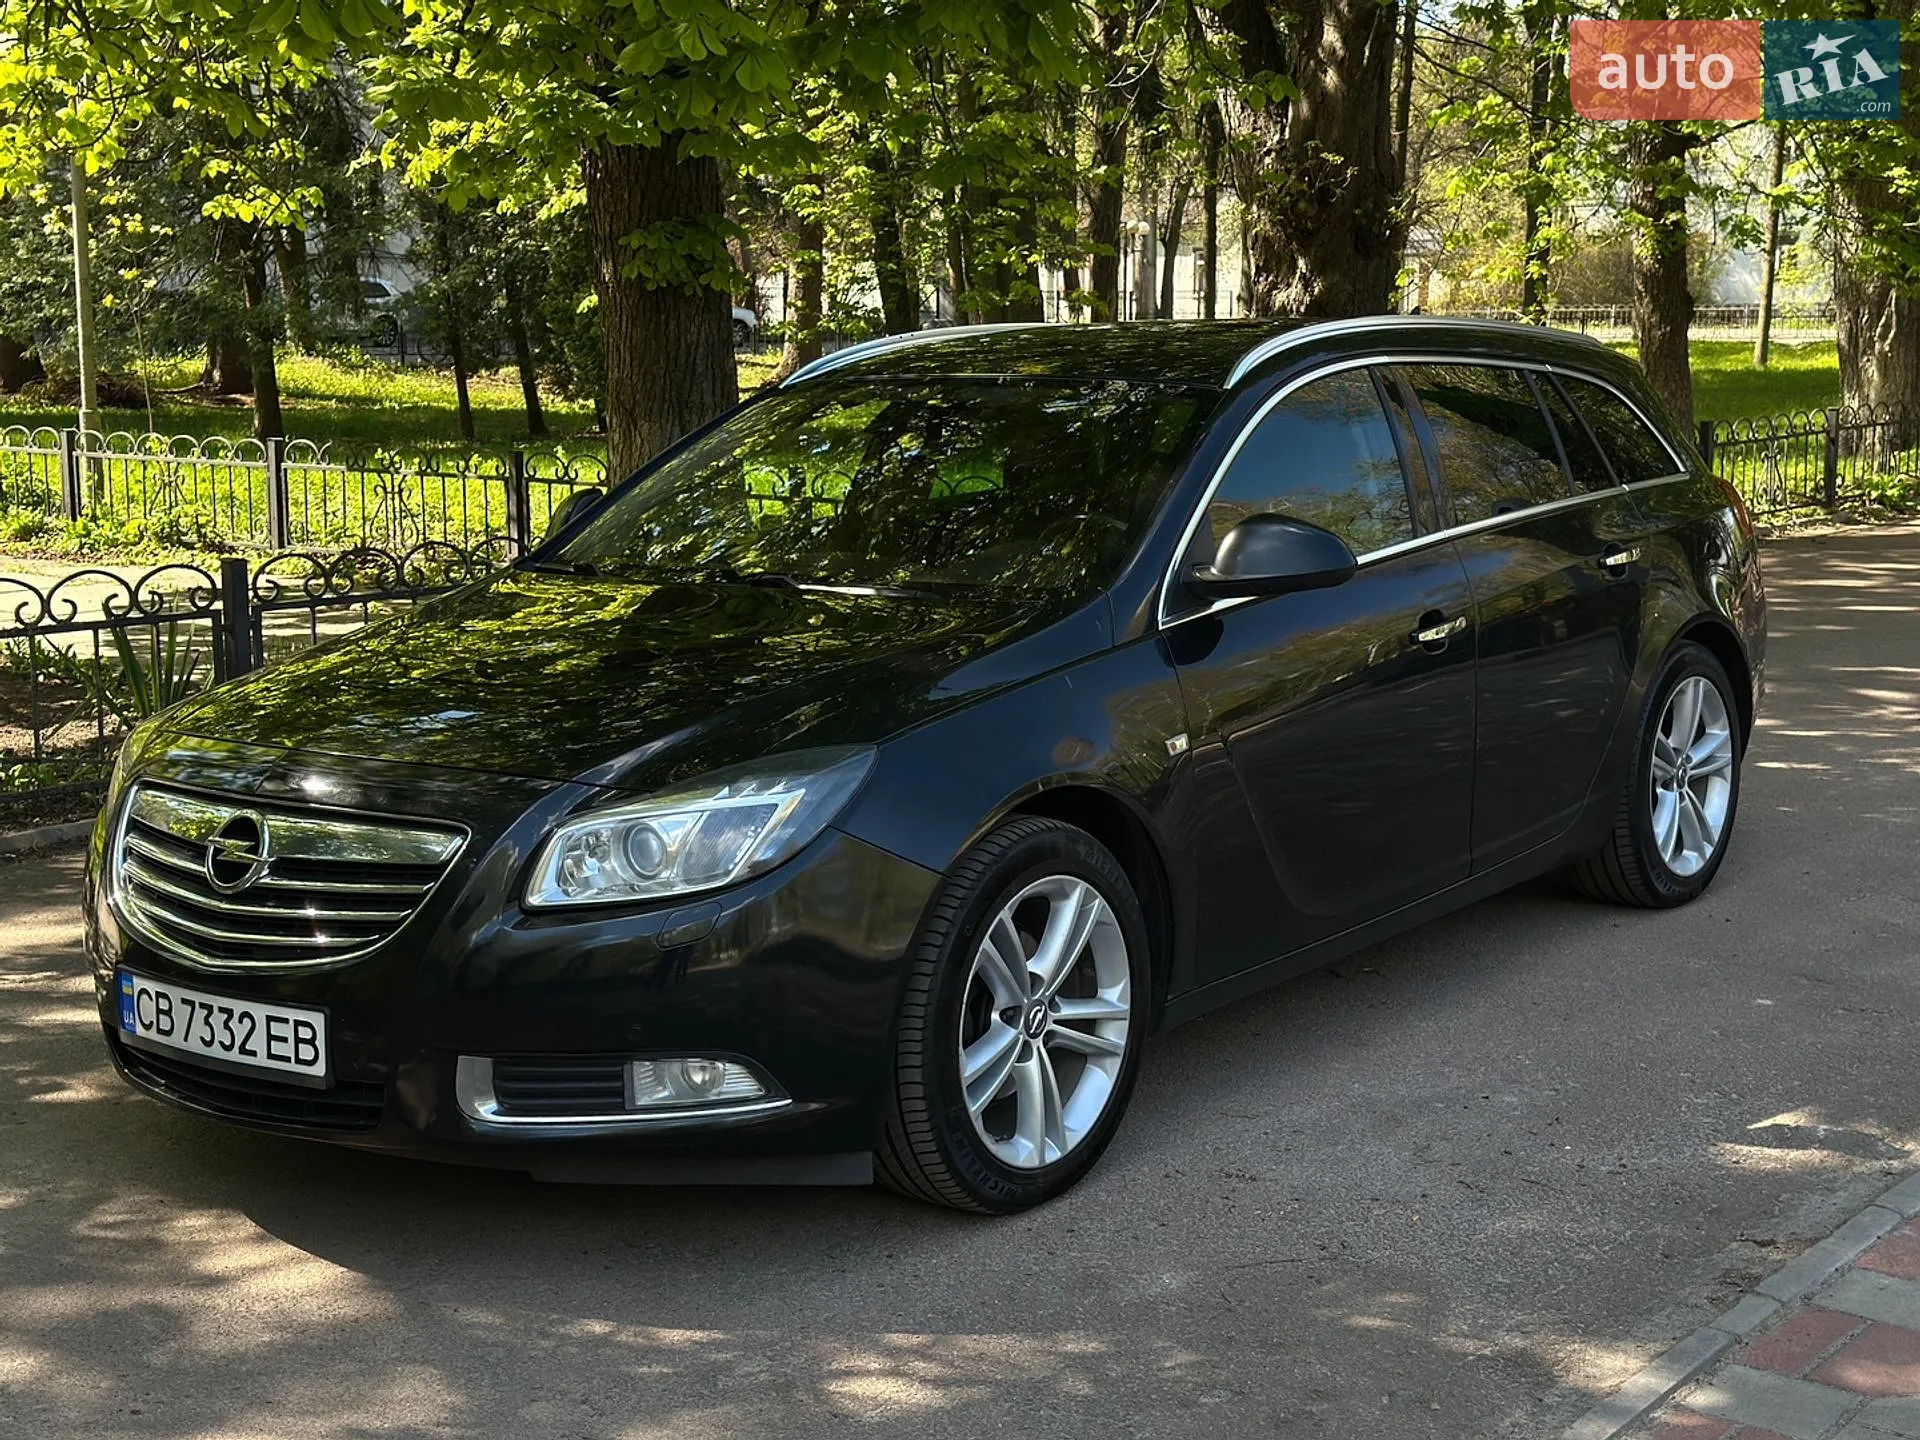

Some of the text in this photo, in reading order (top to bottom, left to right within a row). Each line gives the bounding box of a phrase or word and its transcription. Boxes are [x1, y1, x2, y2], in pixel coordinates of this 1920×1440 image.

[123, 1010, 135, 1025] UA
[136, 988, 320, 1067] CB 7332 EB
